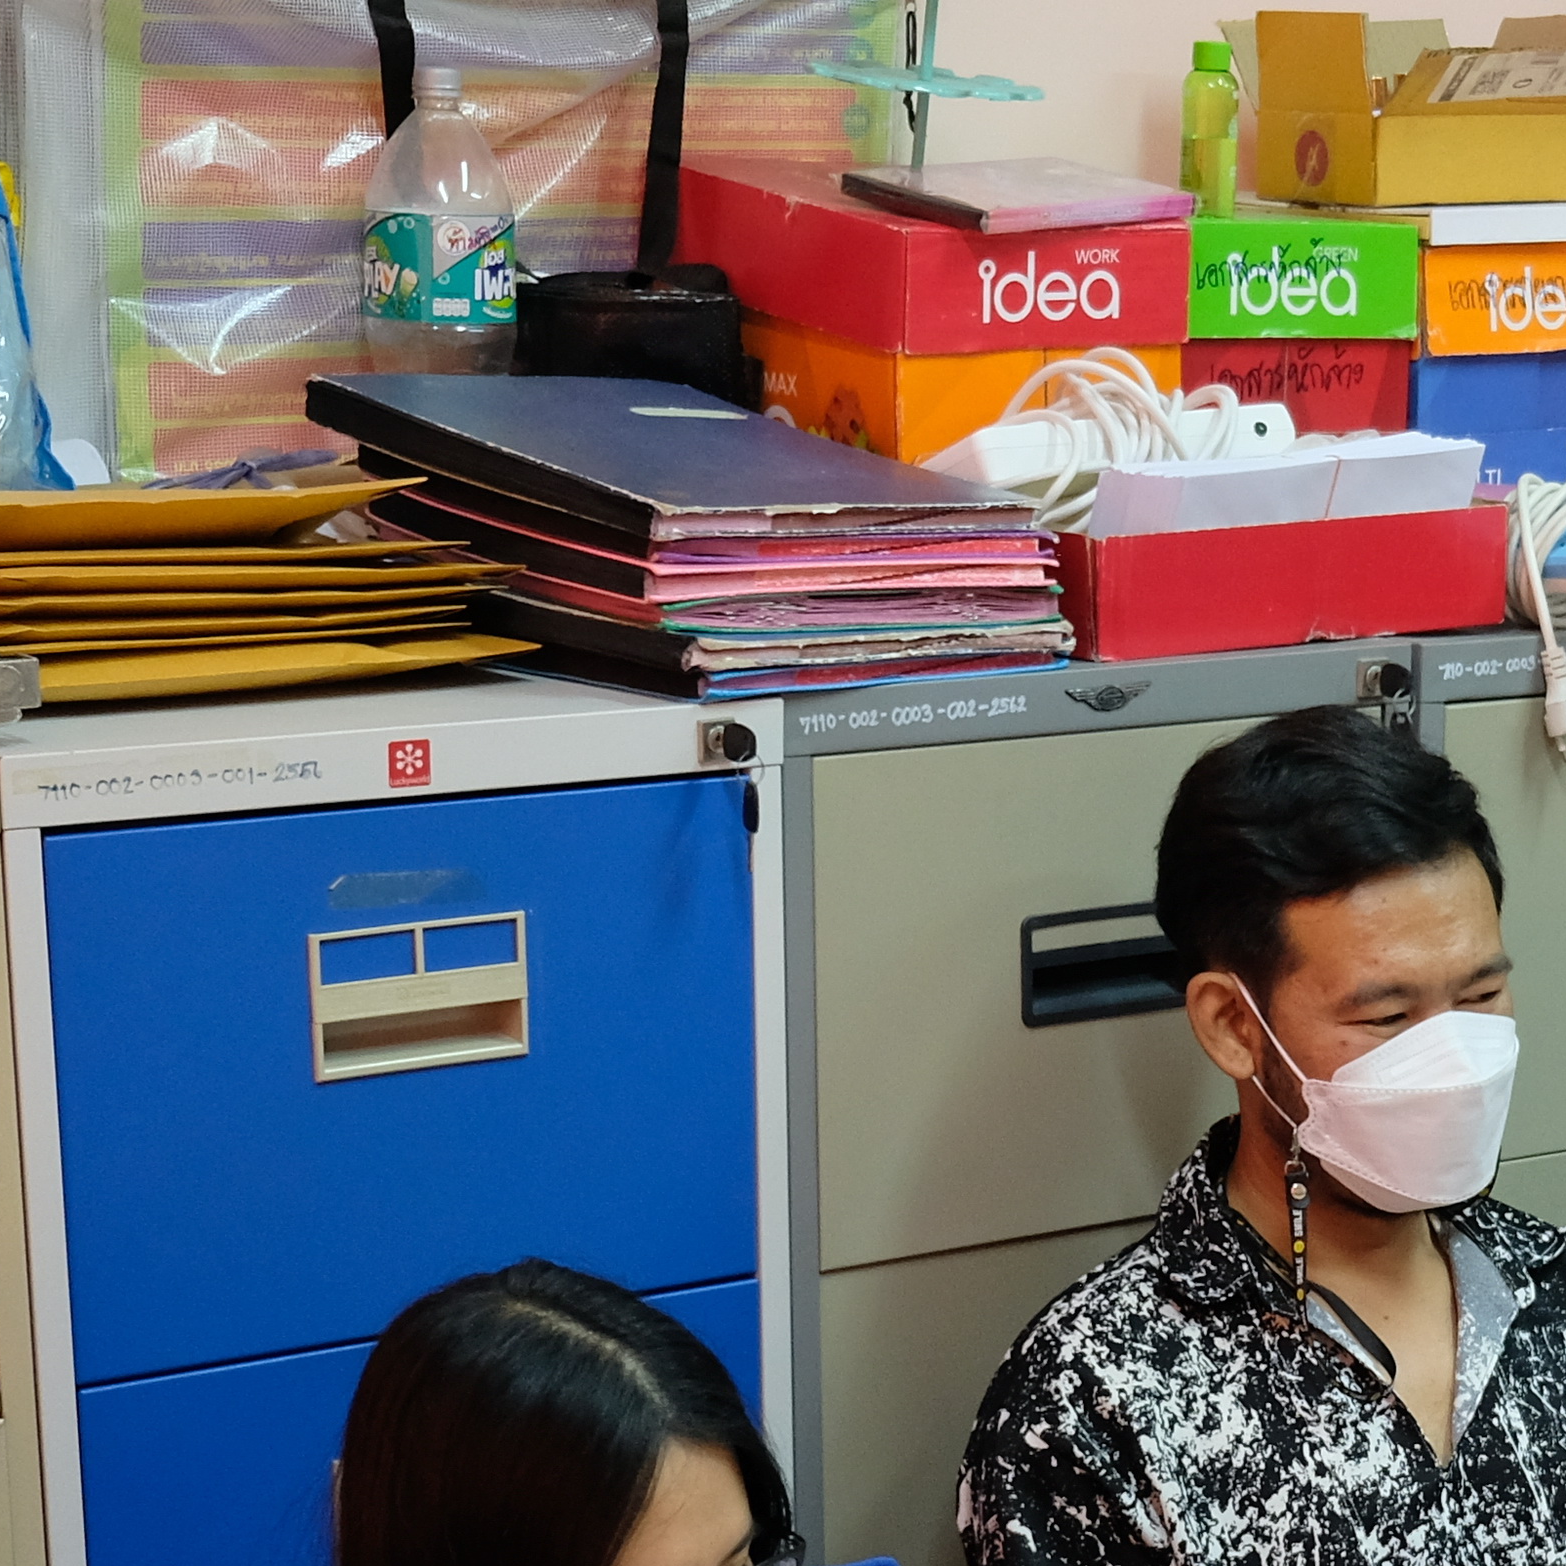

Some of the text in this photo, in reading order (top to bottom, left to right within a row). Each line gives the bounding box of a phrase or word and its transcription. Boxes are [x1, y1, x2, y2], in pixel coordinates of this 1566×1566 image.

[1075, 249, 1120, 264] WORK
[1313, 246, 1359, 262] GREEN
[978, 250, 1120, 324] idea
[1227, 246, 1358, 317] idea
